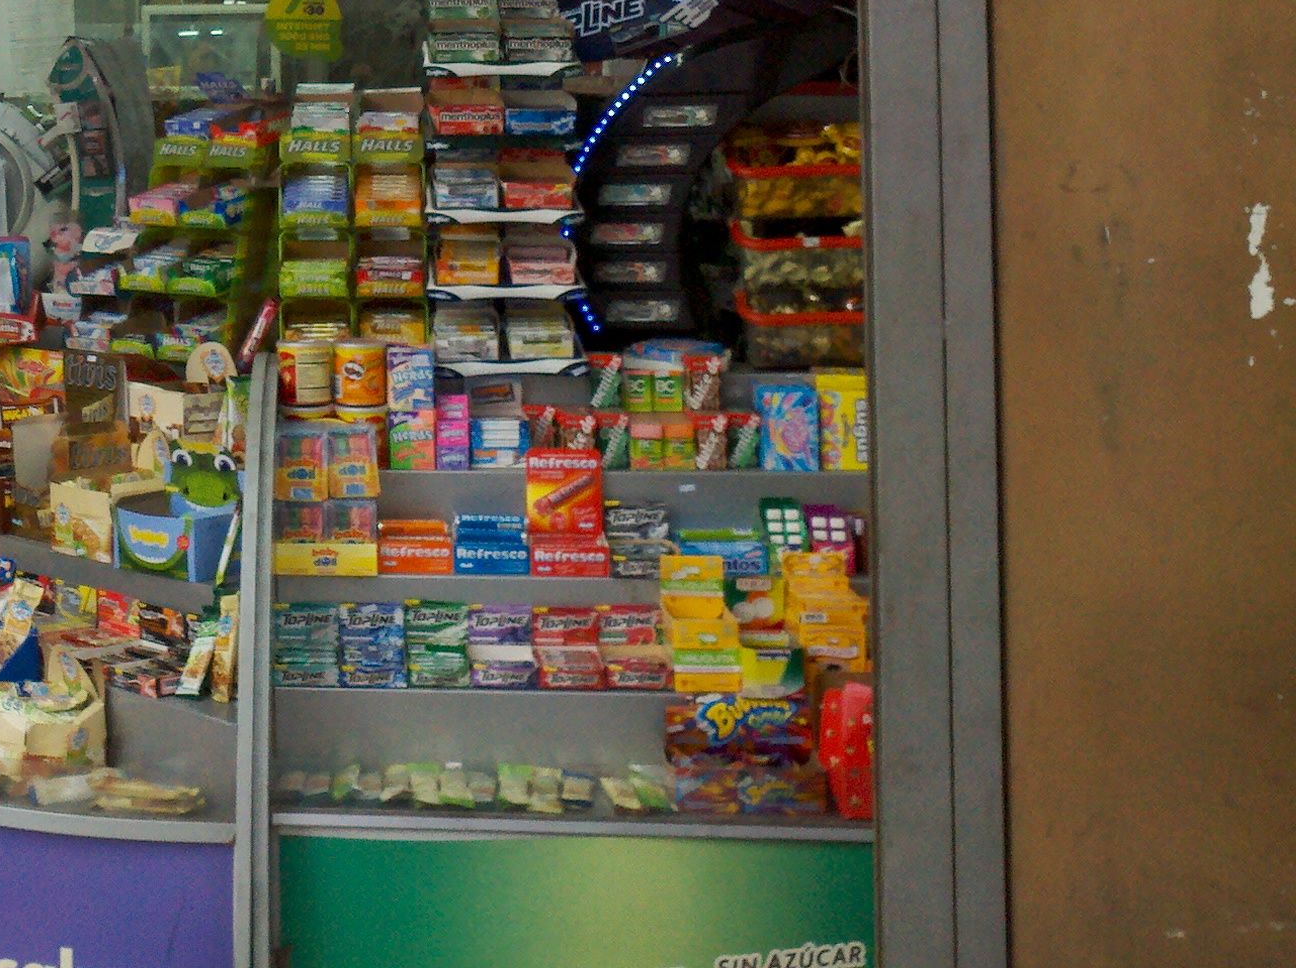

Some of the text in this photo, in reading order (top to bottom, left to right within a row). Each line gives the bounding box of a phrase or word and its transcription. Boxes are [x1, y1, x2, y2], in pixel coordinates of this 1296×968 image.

[441, 112, 502, 122] menthoplus
[159, 143, 198, 157] HALLS
[209, 144, 248, 157] HALLS
[287, 139, 341, 153] HALLS
[360, 139, 414, 153] HALLS
[655, 379, 676, 392] BC
[528, 456, 598, 469] Refresco
[380, 547, 451, 559] Refresco
[456, 548, 528, 561] Refresco
[534, 551, 606, 563] Refresco
[720, 560, 762, 571] ntos
[767, 945, 862, 968] AZÚCAR
